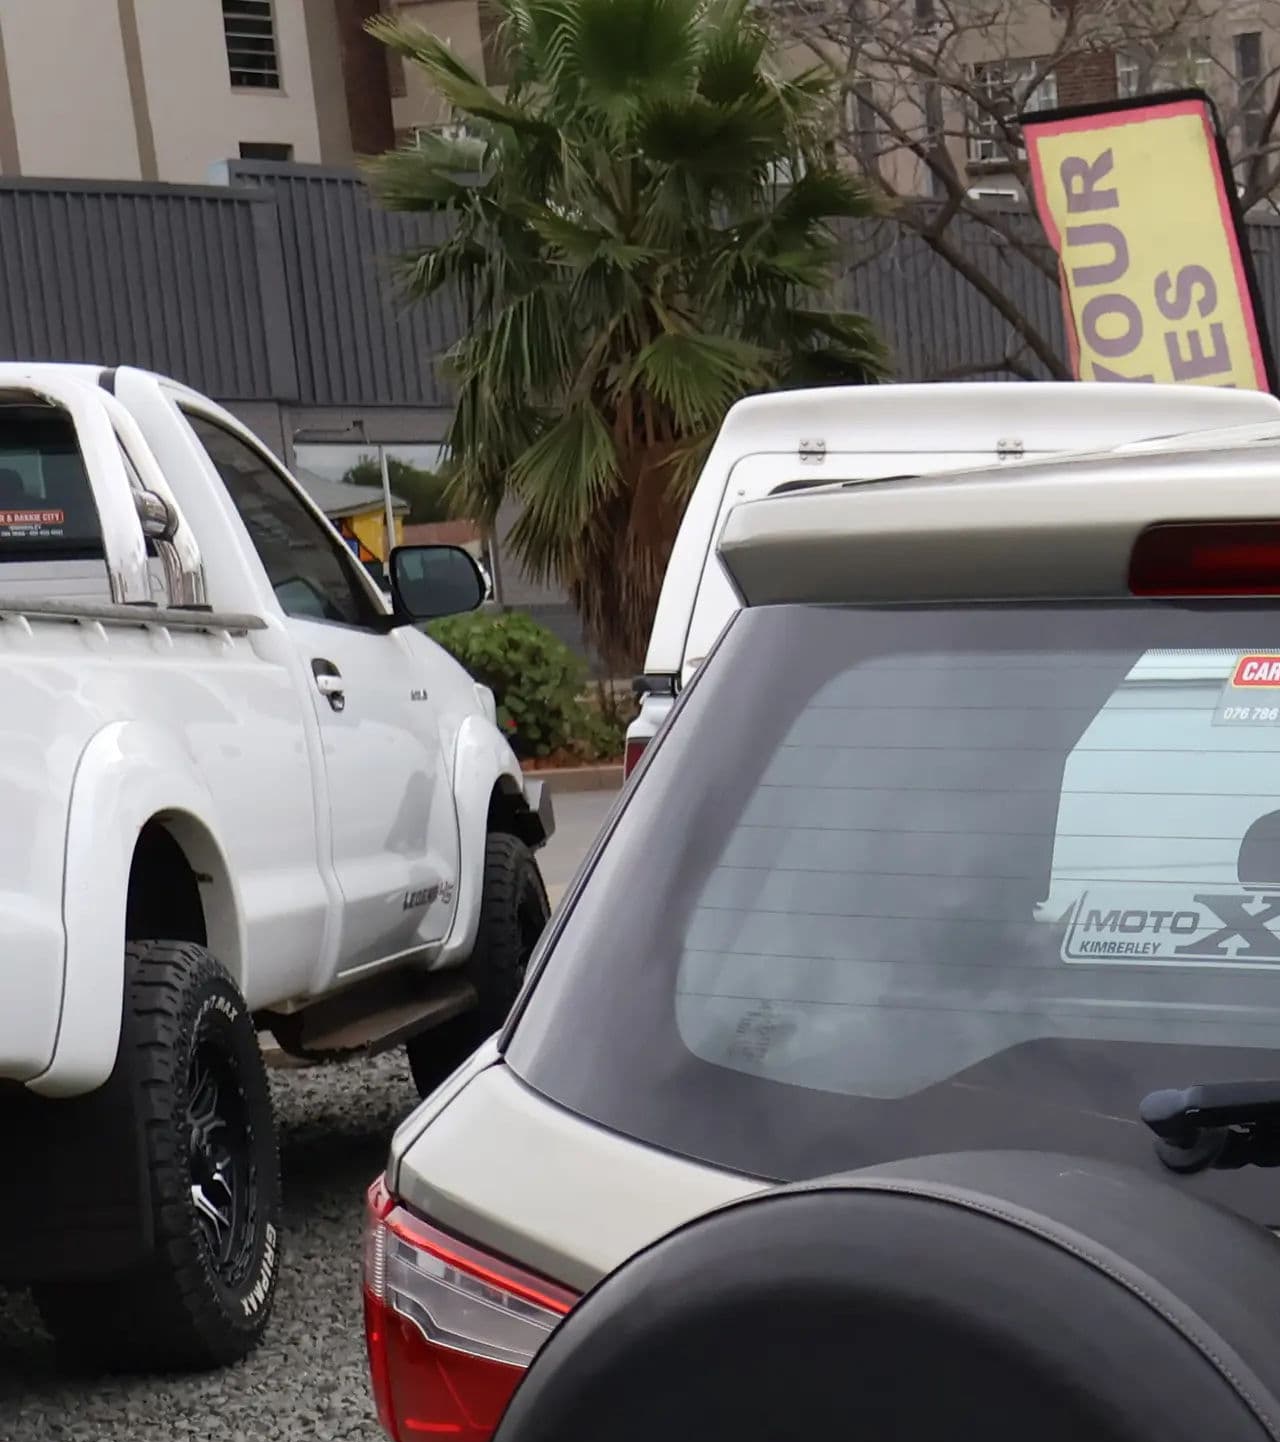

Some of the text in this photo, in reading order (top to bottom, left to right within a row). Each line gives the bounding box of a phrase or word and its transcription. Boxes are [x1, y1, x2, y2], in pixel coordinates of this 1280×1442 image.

[1154, 264, 1237, 387] ES
[1223, 707, 1250, 720] 076
[1079, 940, 1162, 955] KIMBERLEY
[240, 1223, 277, 1317] GRIPMAX
